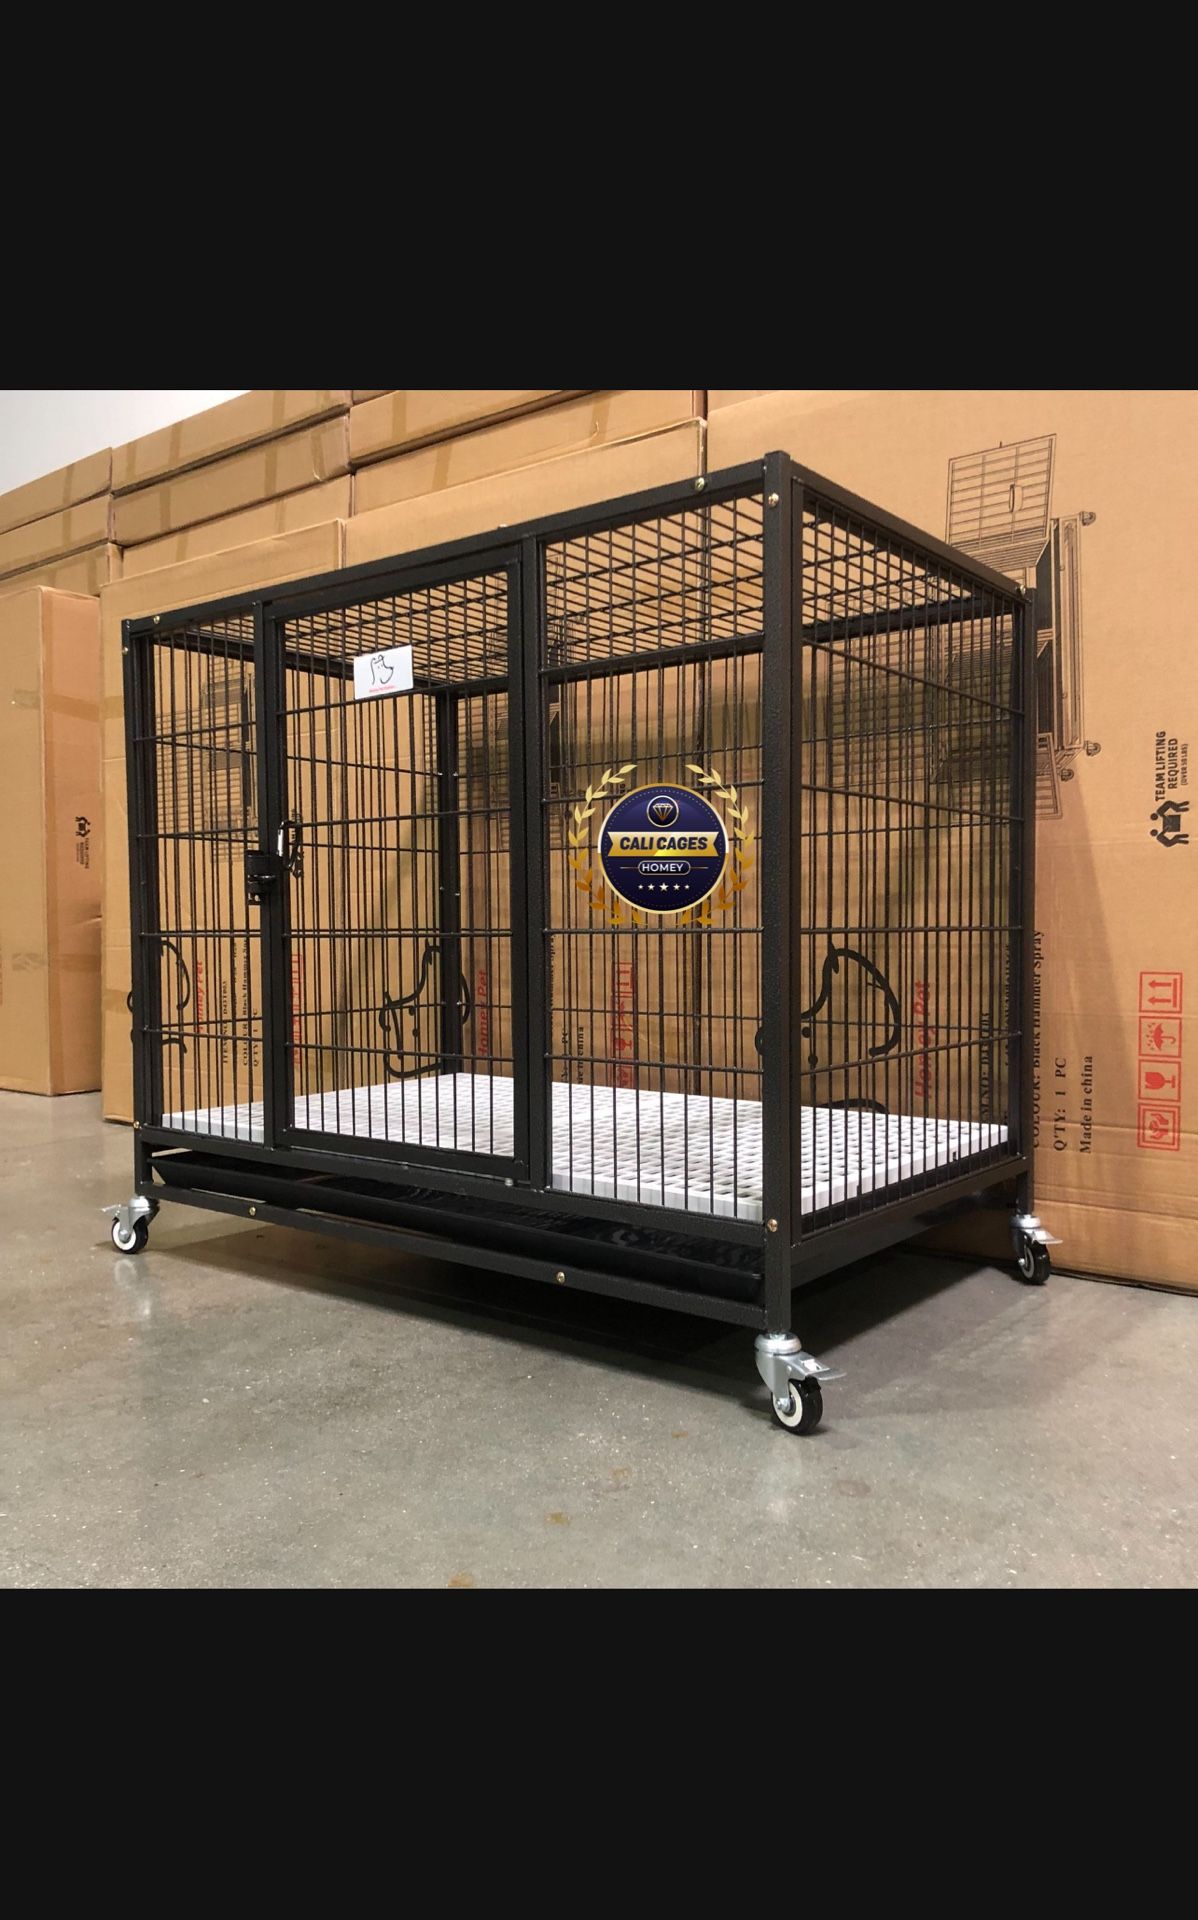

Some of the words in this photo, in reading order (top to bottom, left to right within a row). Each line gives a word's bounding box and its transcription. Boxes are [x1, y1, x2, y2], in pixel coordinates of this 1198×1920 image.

[1155, 731, 1166, 771] LIFTING
[1167, 738, 1179, 790] REQUIRED
[1155, 773, 1166, 802] TEAM
[1032, 930, 1045, 969] Spray
[913, 980, 931, 1017] Pet
[1054, 1057, 1067, 1078] PC
[1080, 1056, 1093, 1094] china
[1080, 1098, 1093, 1112] in
[1053, 1108, 1067, 1152] Q'TY:
[1080, 1115, 1093, 1154] Made
